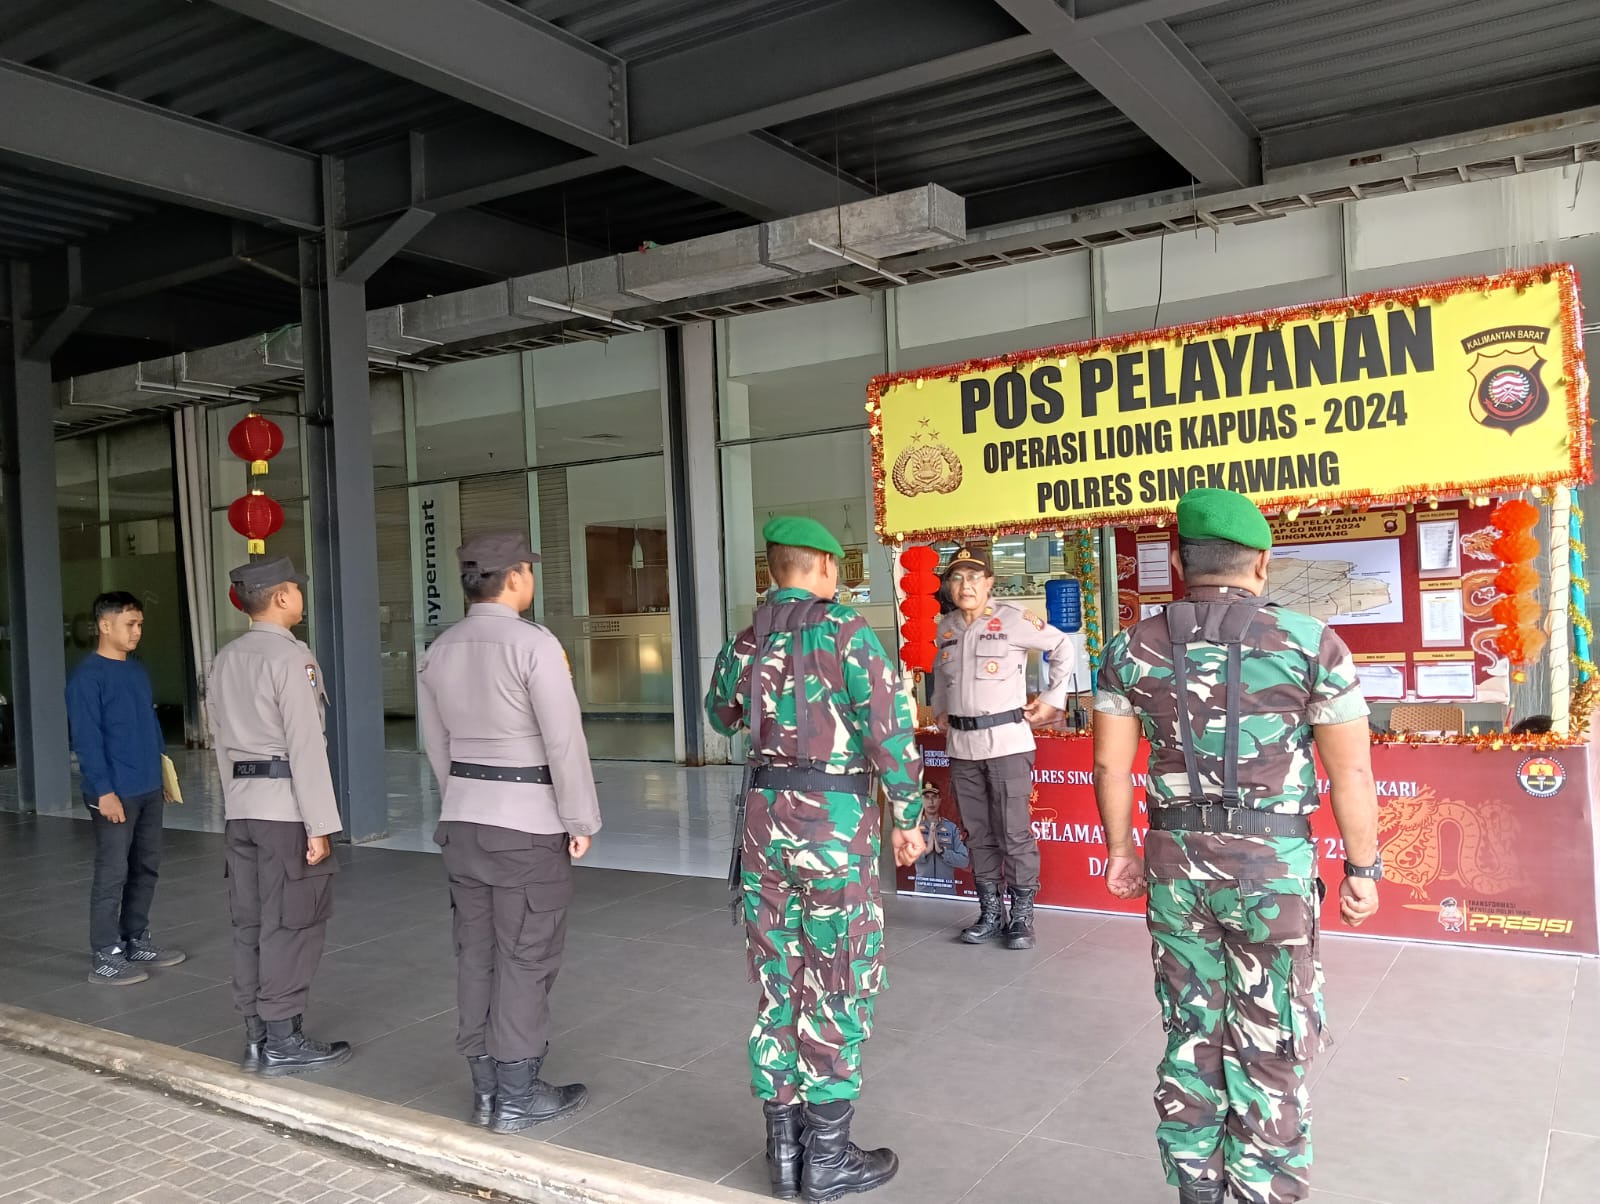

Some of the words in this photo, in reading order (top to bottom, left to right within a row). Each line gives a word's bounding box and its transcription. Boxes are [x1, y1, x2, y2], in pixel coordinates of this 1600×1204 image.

[1466, 330, 1516, 350] KALIMANTAN
[1517, 330, 1545, 340] BARAT
[960, 365, 1065, 434] POS
[1079, 306, 1434, 418] PELAYANAN
[983, 430, 1087, 473] OPERASI
[1093, 419, 1173, 460] LIONG
[1179, 403, 1298, 451] KAPUAS
[1319, 390, 1408, 434] 2024
[1037, 472, 1133, 513] POLRES
[1139, 450, 1340, 503] SINGKAWANG
[1278, 517, 1299, 528] POS
[1303, 516, 1366, 526] PELAYANAN
[1290, 526, 1305, 534] GO
[1308, 524, 1331, 532] MEH
[1335, 522, 1361, 530] 2024
[1274, 530, 1348, 541] SINGKAWANG
[421, 499, 442, 627] hypermart
[979, 632, 1008, 641] POLRI
[236, 764, 257, 776] POLRI
[1469, 913, 1574, 937] PRESISI
